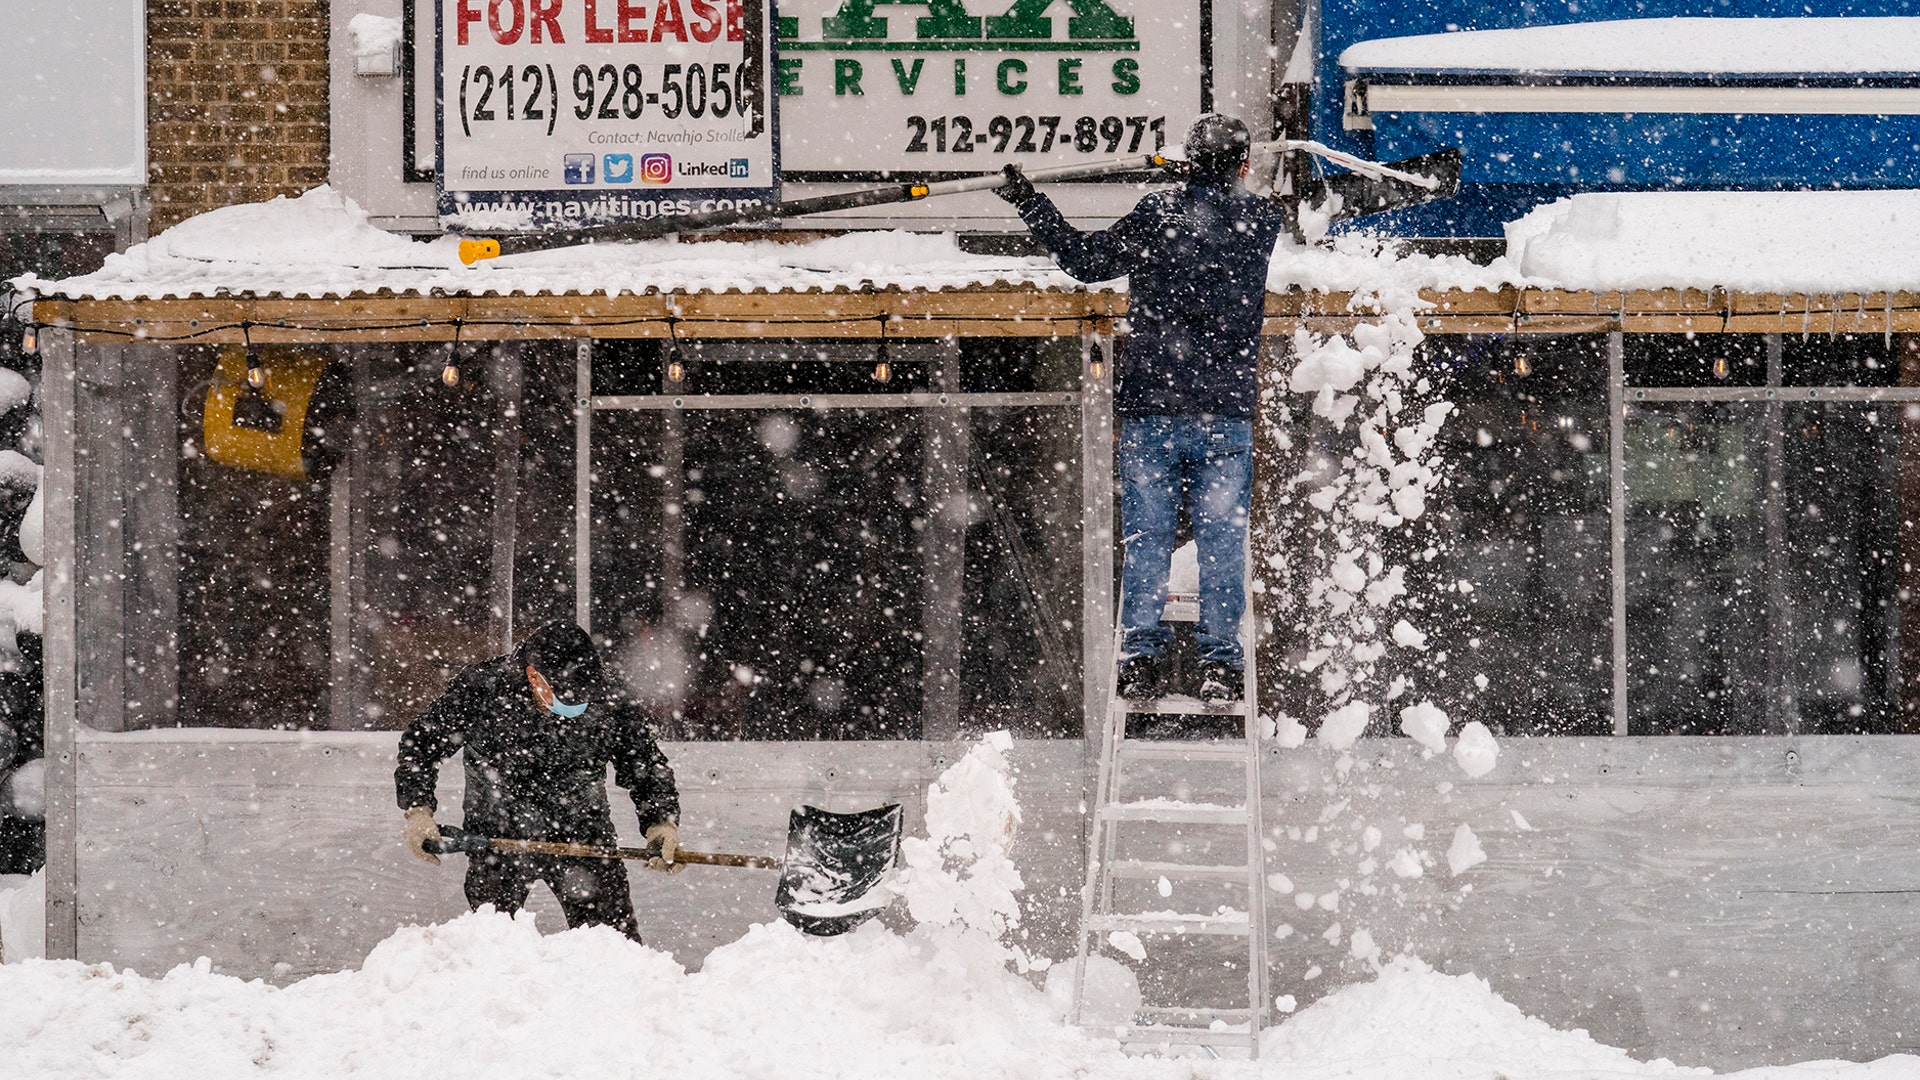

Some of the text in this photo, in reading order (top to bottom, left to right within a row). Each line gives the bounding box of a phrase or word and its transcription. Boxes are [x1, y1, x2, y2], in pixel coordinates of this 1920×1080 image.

[457, 0, 566, 46] FOR
[459, 64, 558, 137] (212)
[588, 130, 643, 145] Contact:
[647, 129, 702, 146] Navahjo
[905, 116, 1166, 153] 212-927-8971
[462, 165, 488, 179] find
[491, 168, 506, 179] us
[509, 166, 550, 179] online
